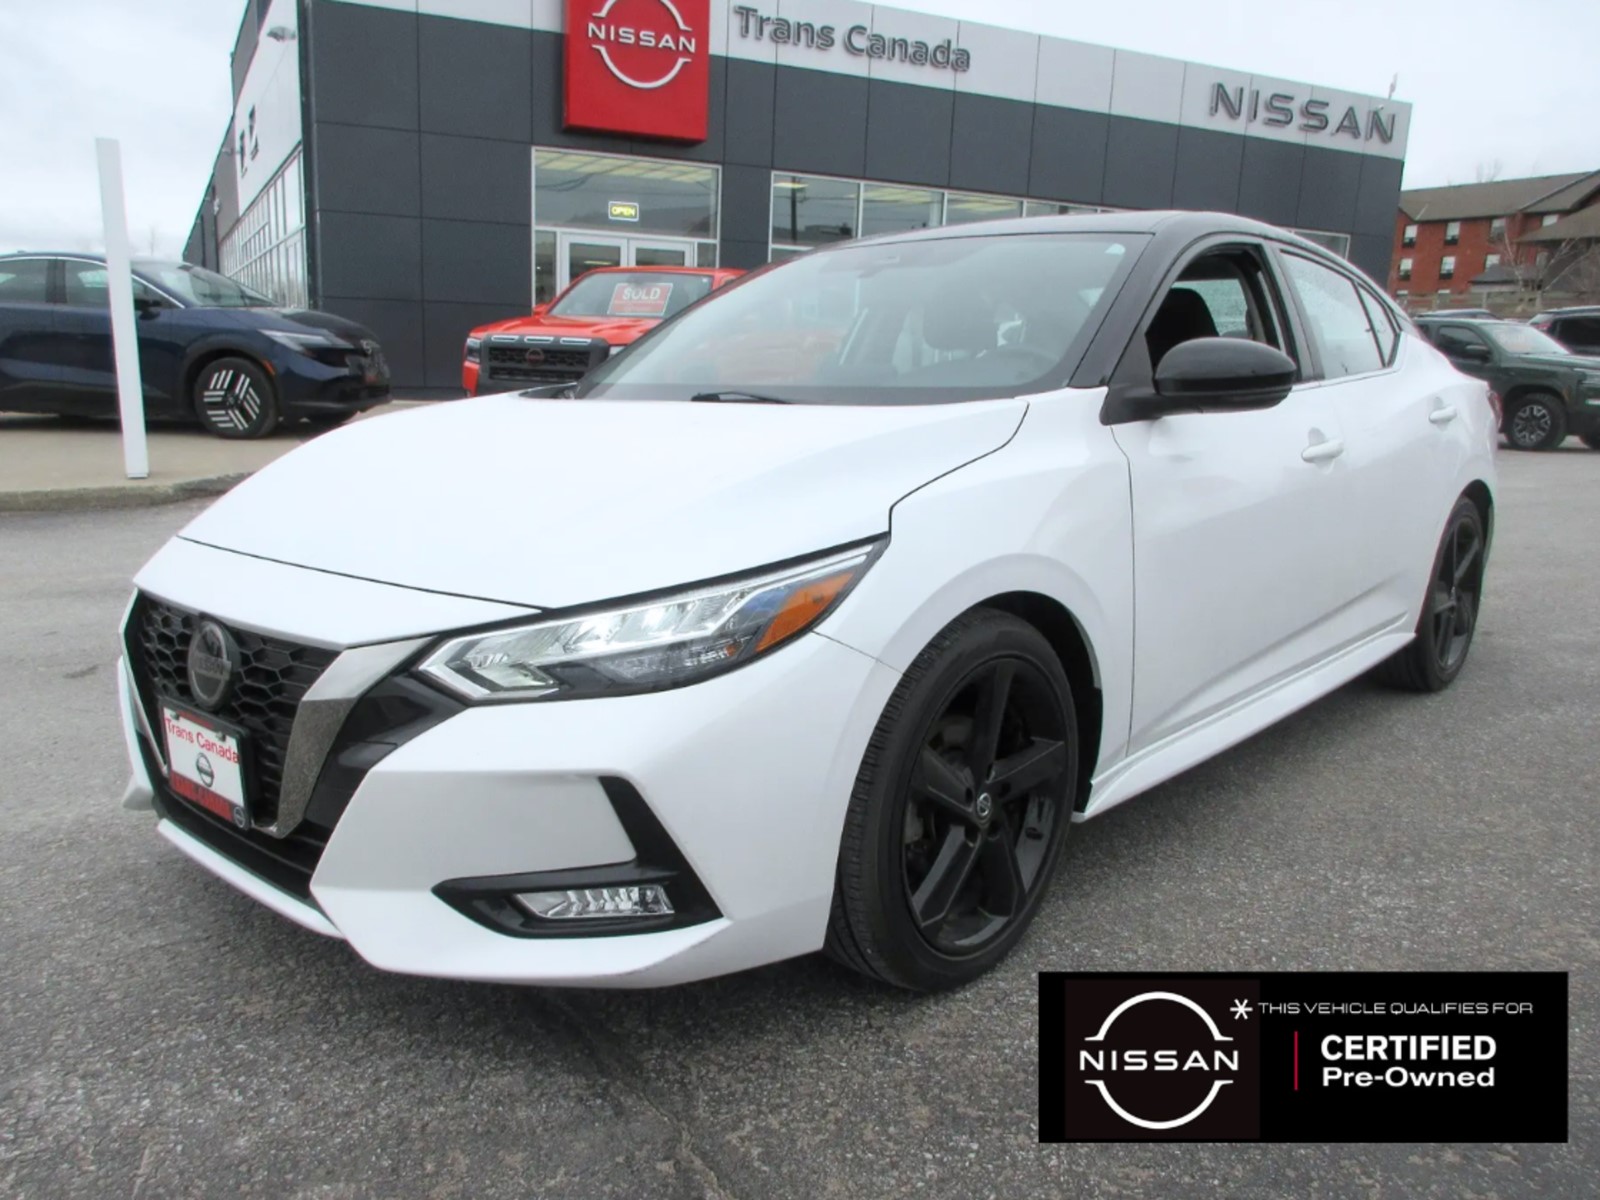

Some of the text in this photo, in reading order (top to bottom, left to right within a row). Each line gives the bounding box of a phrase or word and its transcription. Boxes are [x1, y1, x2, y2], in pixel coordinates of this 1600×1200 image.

[588, 22, 696, 53] NISSAN
[734, 5, 971, 72] Trans Canada
[1210, 82, 1395, 144] NISSAN
[611, 206, 636, 216] OPEN
[622, 287, 661, 300] SOLD
[165, 718, 194, 743] Trans
[196, 732, 239, 763] Canada
